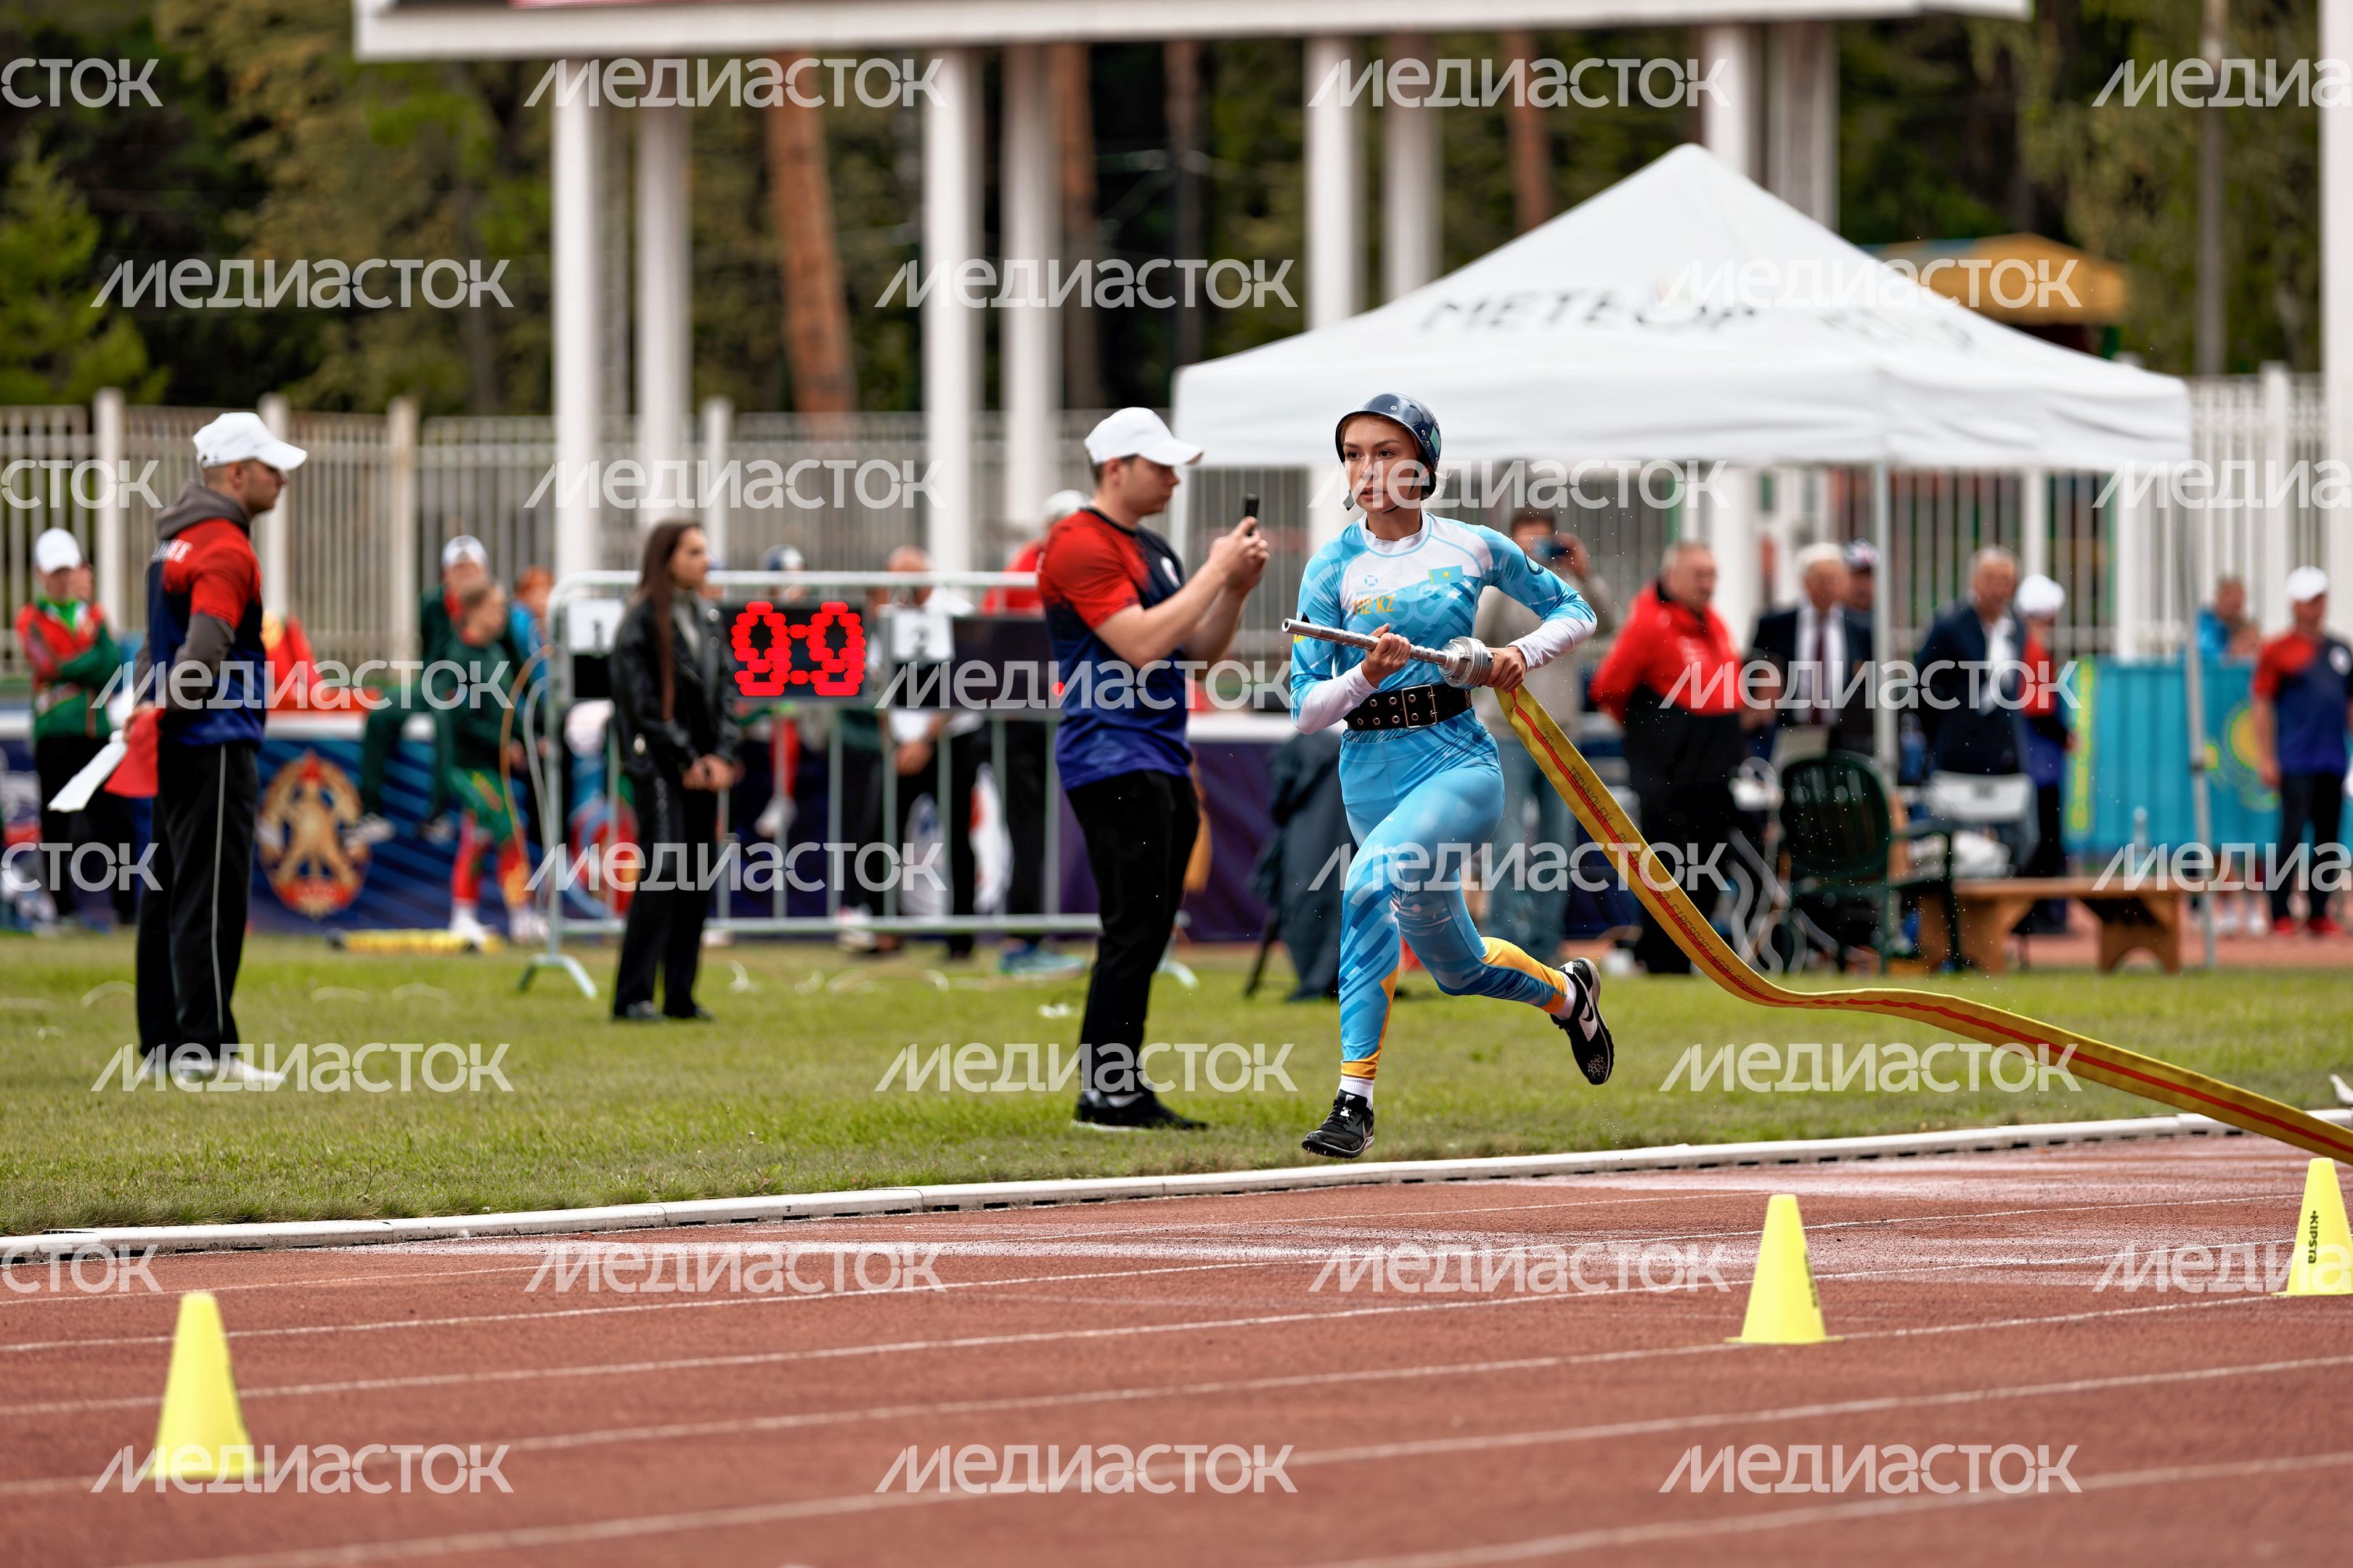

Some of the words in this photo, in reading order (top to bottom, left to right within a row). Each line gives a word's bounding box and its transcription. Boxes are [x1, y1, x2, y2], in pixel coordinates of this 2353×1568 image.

[1355, 587, 1390, 597] centurion
[1353, 597, 1373, 616] 112
[1375, 595, 1395, 614] KZ
